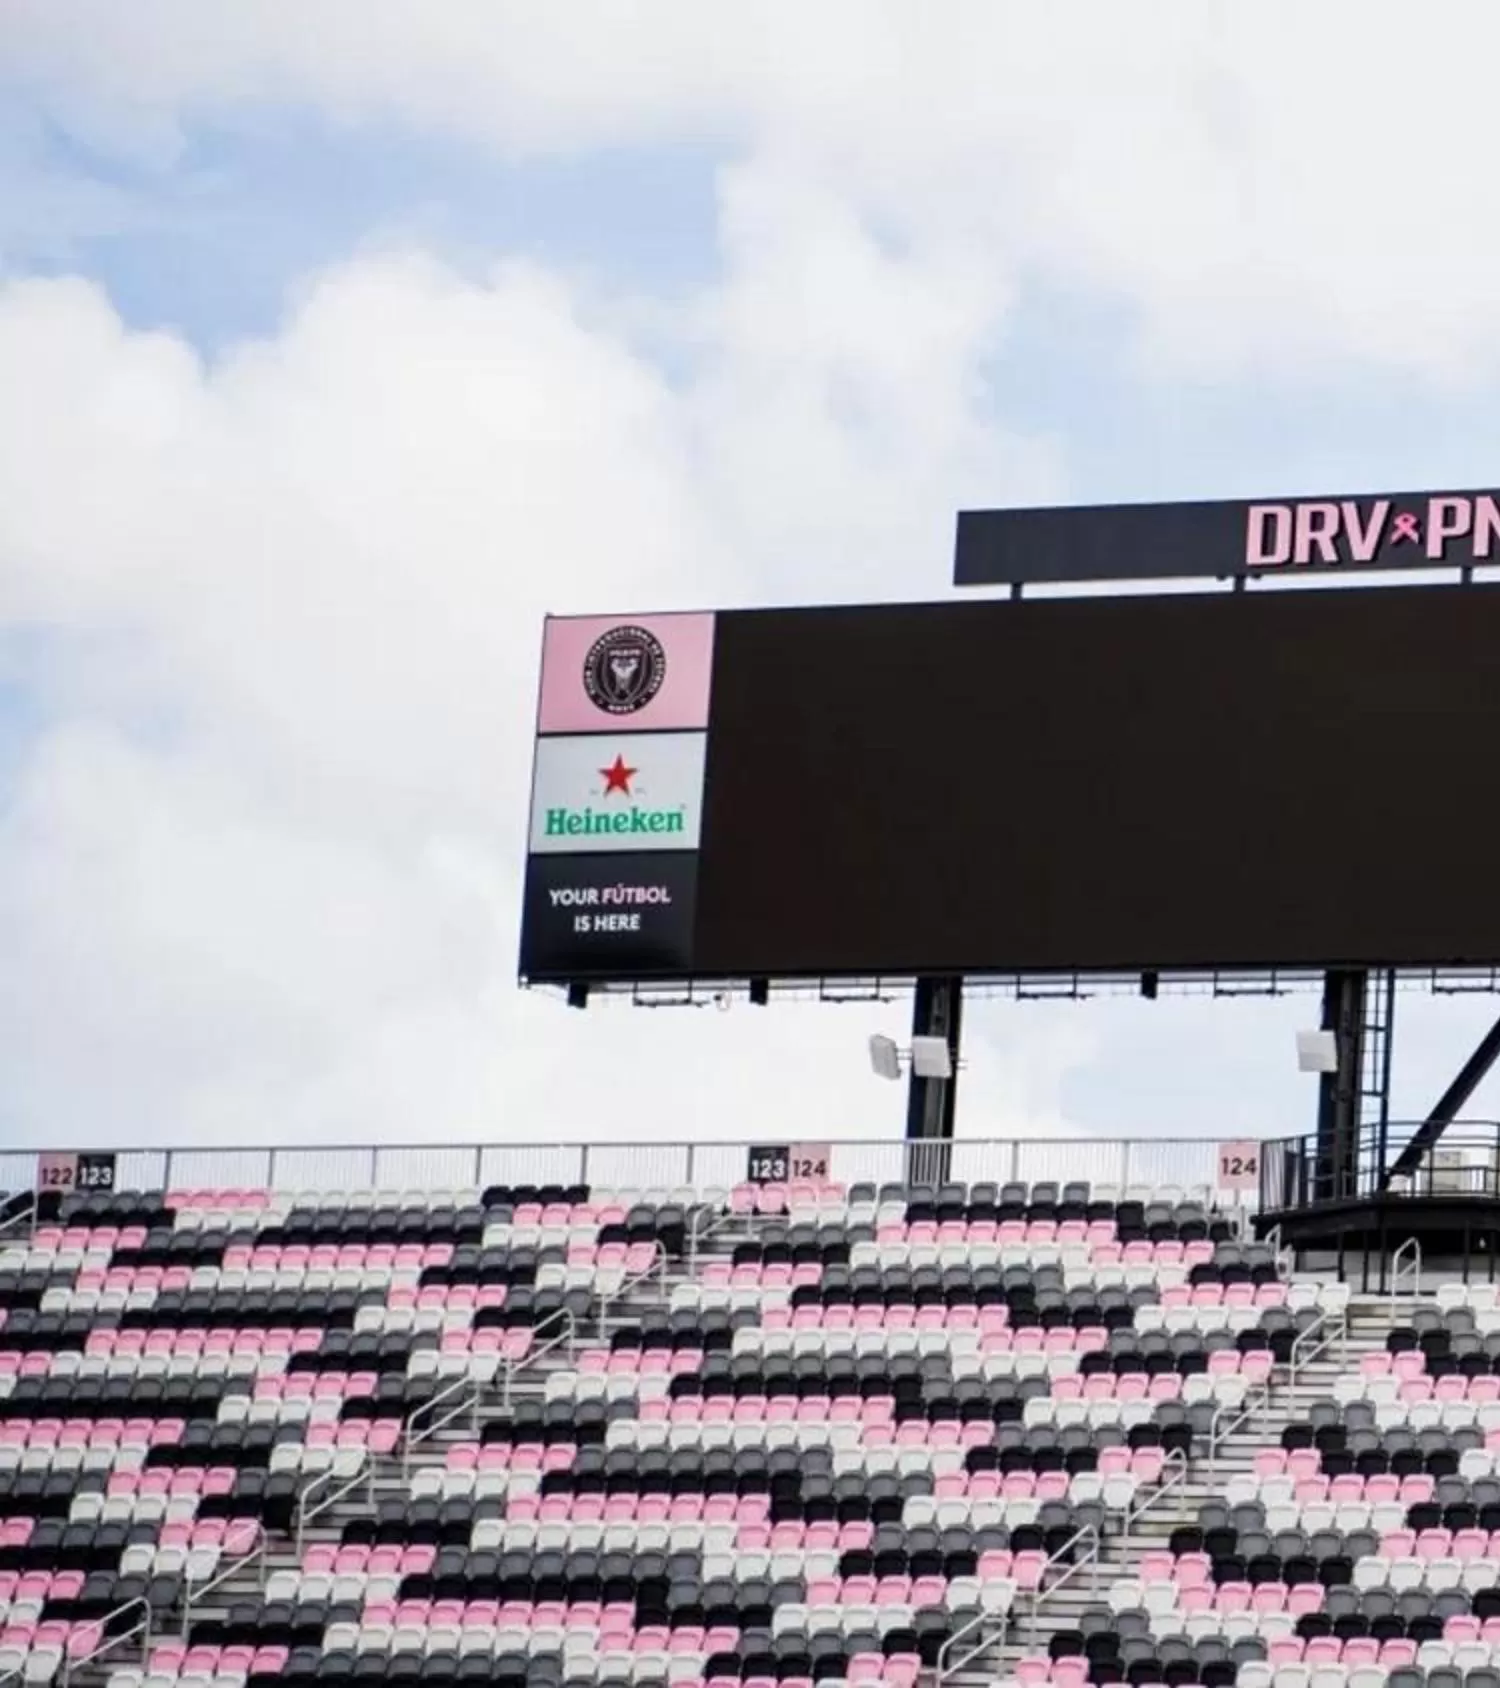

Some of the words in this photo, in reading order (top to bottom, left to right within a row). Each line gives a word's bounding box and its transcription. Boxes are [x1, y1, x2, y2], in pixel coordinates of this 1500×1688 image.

[1246, 500, 1391, 566] DRV
[544, 804, 684, 836] Heineken
[548, 886, 600, 906] YOUR
[602, 882, 672, 904] FÚTBOL
[574, 915, 592, 932] IS
[594, 913, 641, 932] HERE
[752, 1159, 785, 1178] 123
[793, 1159, 826, 1177] 124
[1221, 1157, 1257, 1175] 124
[42, 1167, 73, 1185] 122
[81, 1167, 113, 1185] 123
